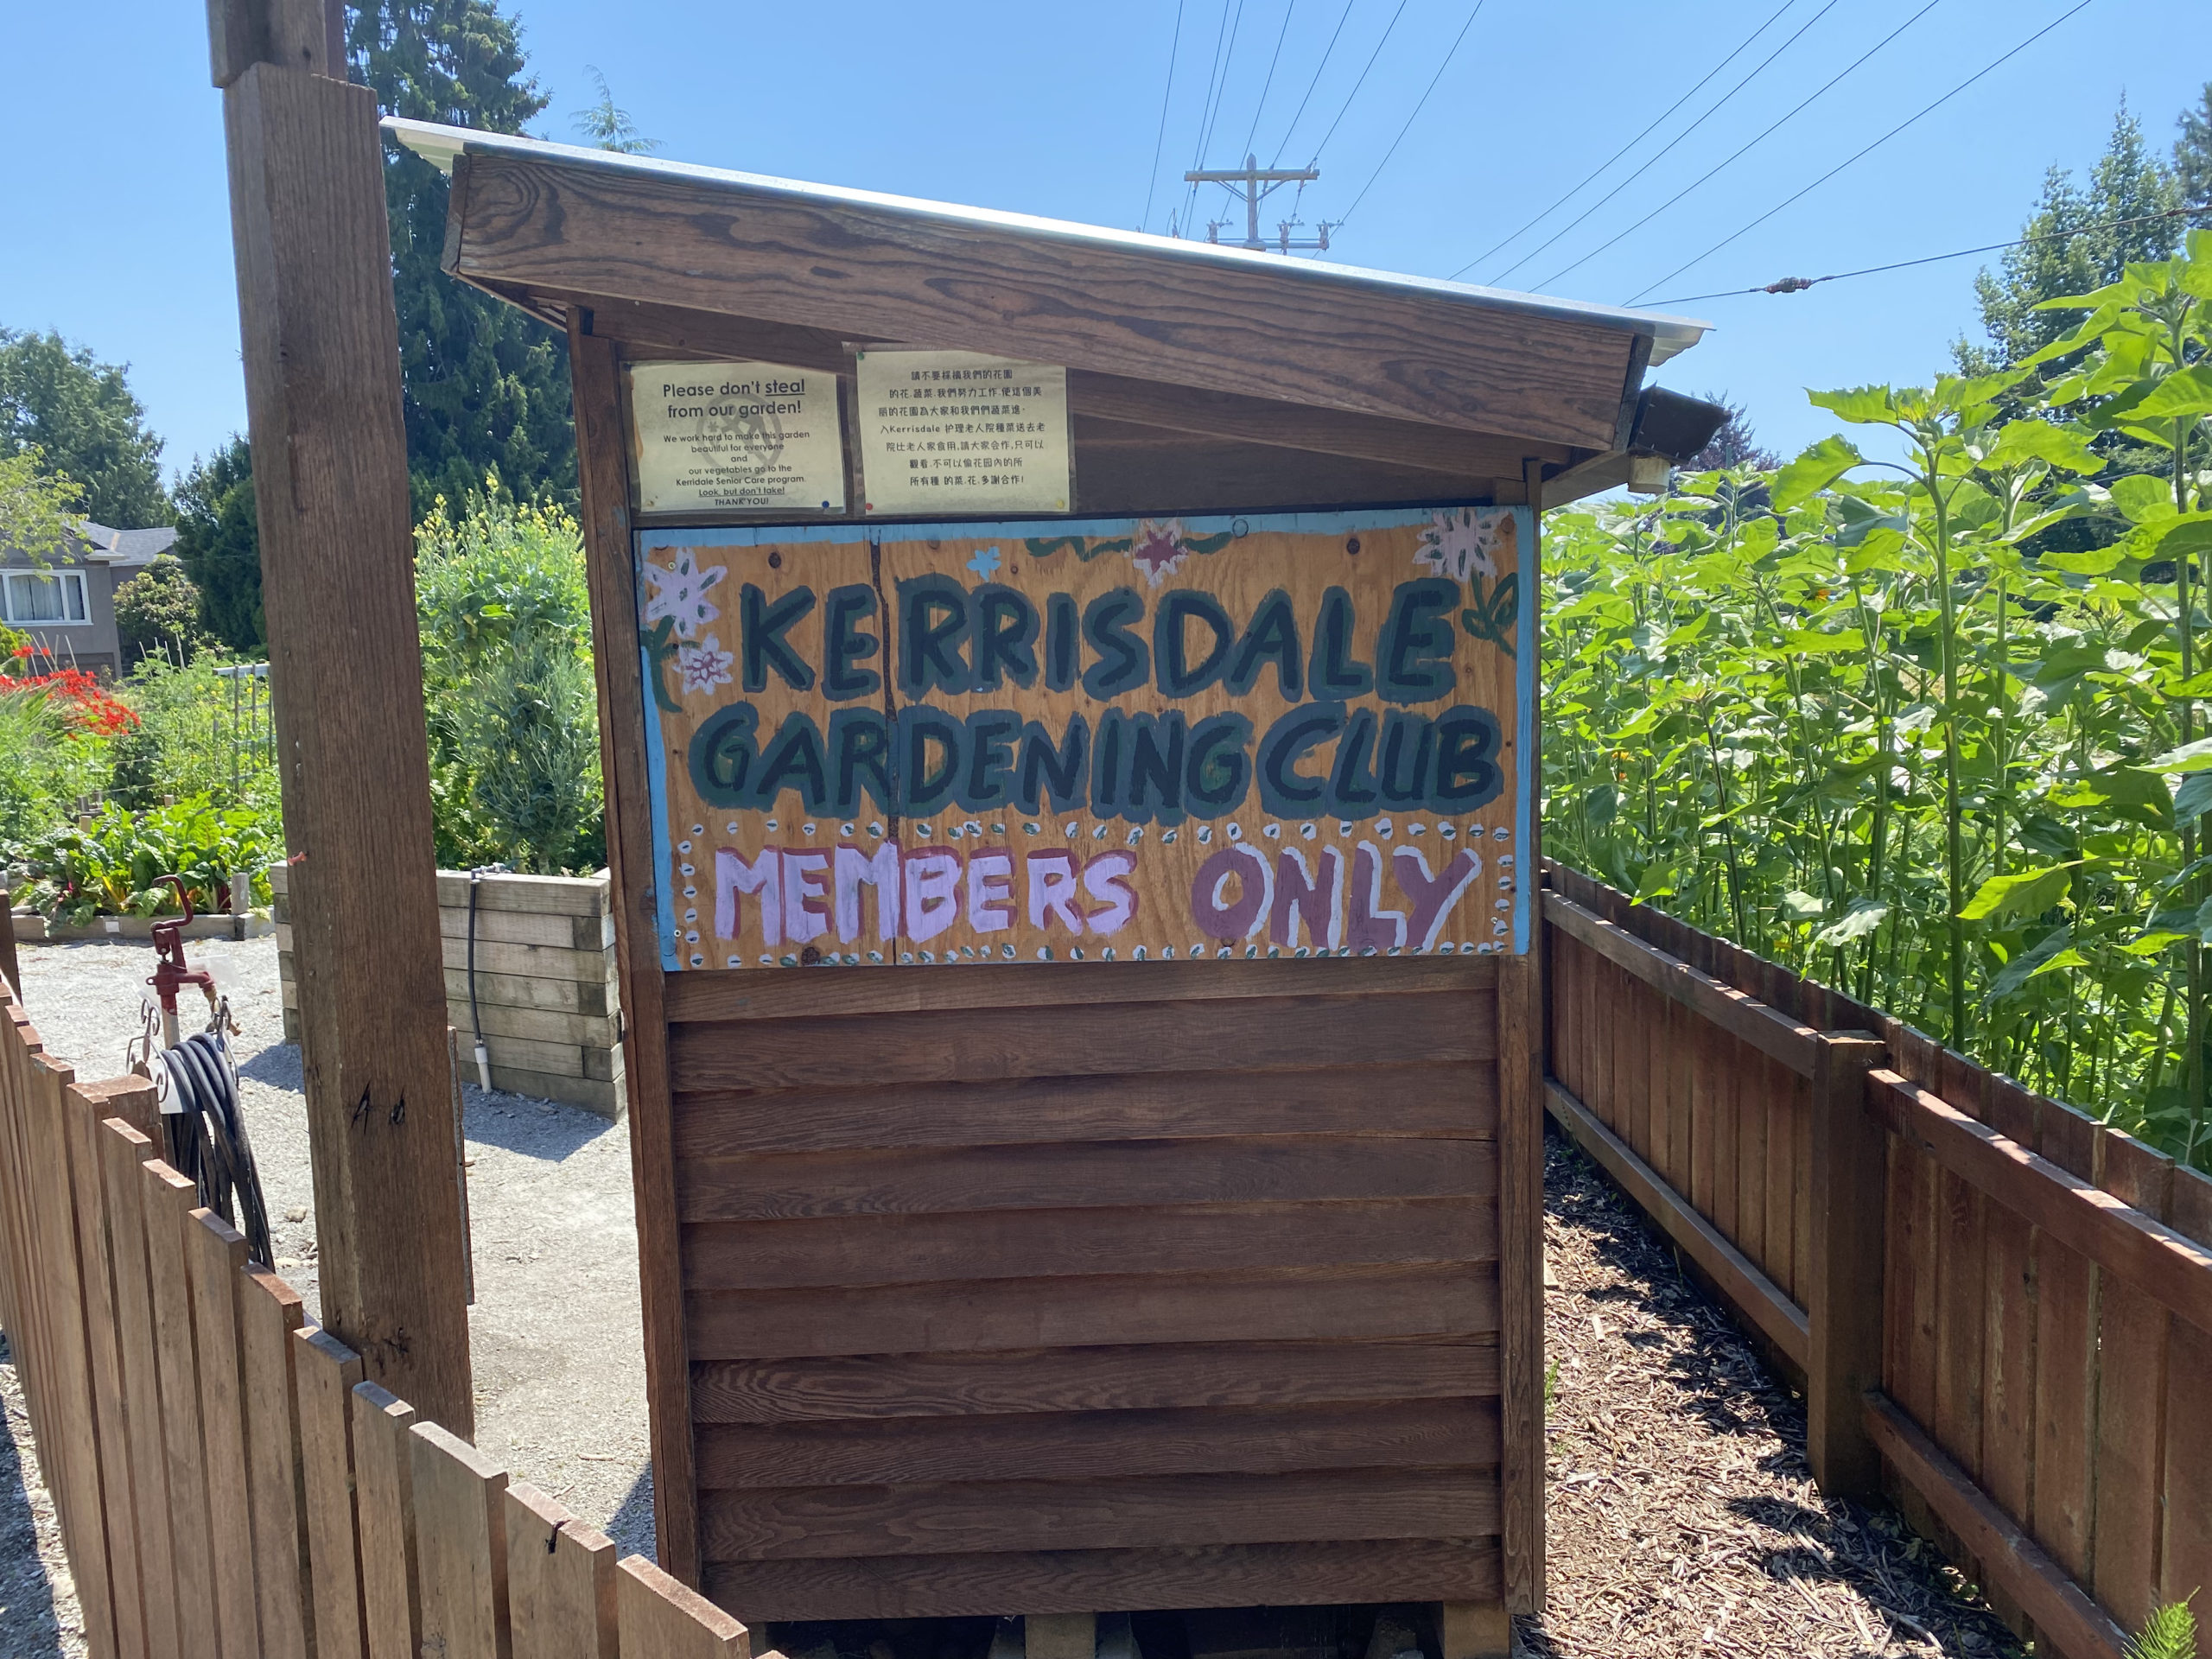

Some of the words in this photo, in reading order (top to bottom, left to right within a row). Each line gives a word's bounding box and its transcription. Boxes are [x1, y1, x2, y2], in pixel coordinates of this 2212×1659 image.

[663, 384, 715, 397] Please
[720, 380, 760, 395] don't
[765, 378, 805, 395] steal
[668, 404, 703, 418] from
[709, 404, 734, 417] our
[739, 400, 802, 418] garden!
[779, 431, 810, 441] garden
[691, 443, 728, 454] beautiful
[744, 442, 785, 453] everyone
[730, 454, 747, 463] and
[705, 466, 753, 476] vegetables
[676, 478, 714, 486] Kerridale
[716, 477, 741, 486] Senior
[744, 476, 766, 485] Care
[767, 476, 806, 486] program.
[723, 487, 737, 496] but
[763, 486, 785, 495] take!
[741, 576, 1460, 702] KERRISDALE
[691, 702, 1255, 824] GARDENING
[1258, 702, 1504, 820] CLUB
[714, 838, 1140, 944] MEMBERS
[1192, 840, 1484, 951] ONLY
